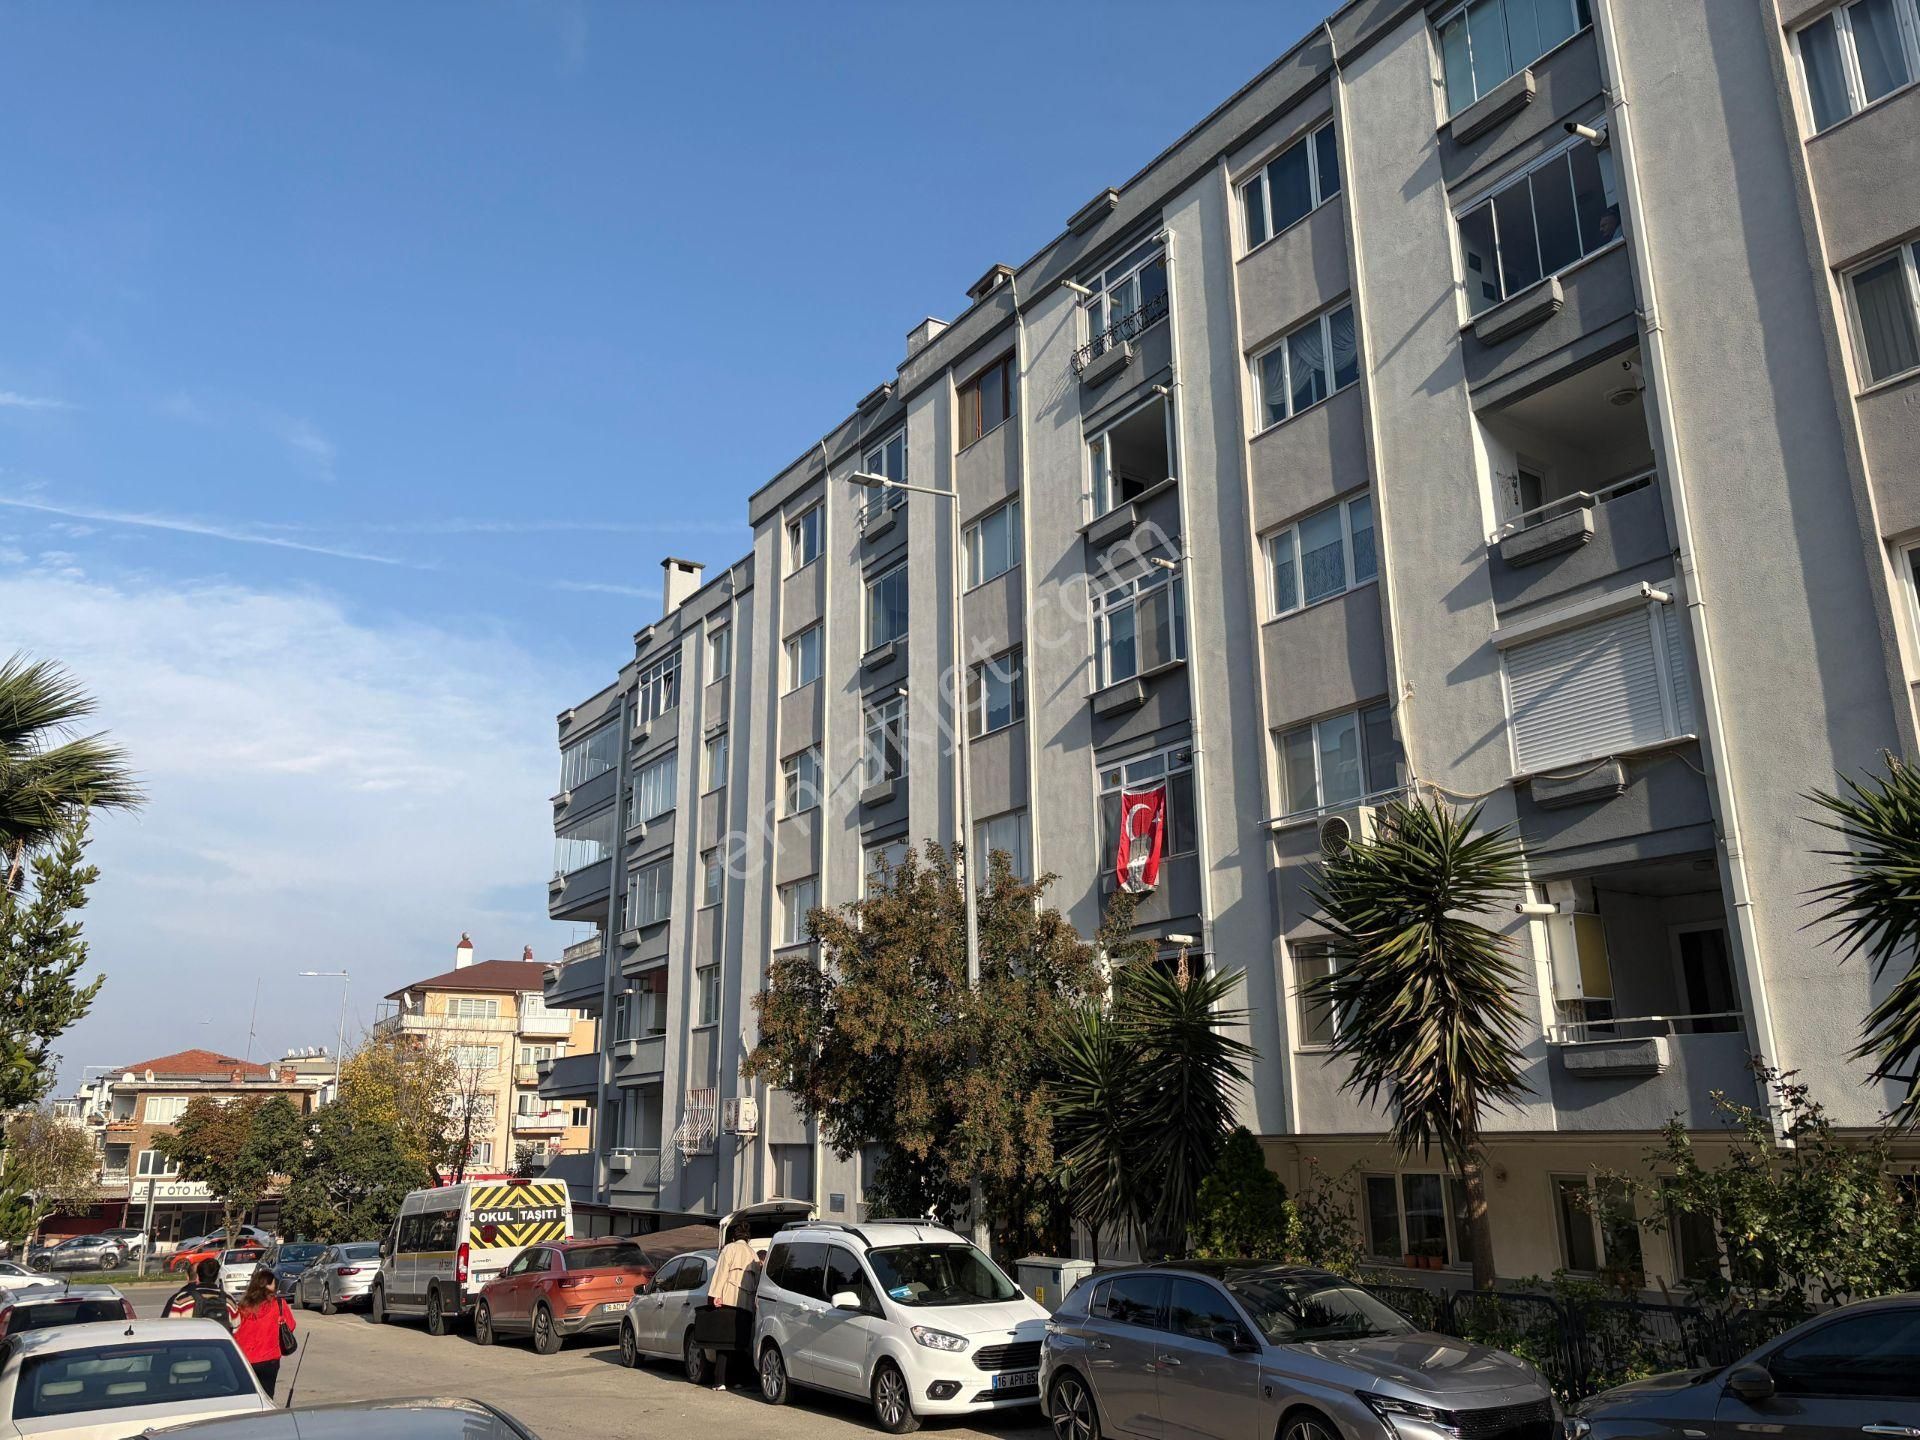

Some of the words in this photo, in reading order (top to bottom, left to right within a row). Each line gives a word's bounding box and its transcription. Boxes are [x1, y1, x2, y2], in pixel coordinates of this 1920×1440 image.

[135, 1186, 164, 1196] JET
[167, 1186, 191, 1196] OTO
[478, 1211, 514, 1223] OKUL
[520, 1209, 557, 1222] TAŞITI
[998, 1376, 1007, 1388] 16
[1010, 1373, 1024, 1386] APH
